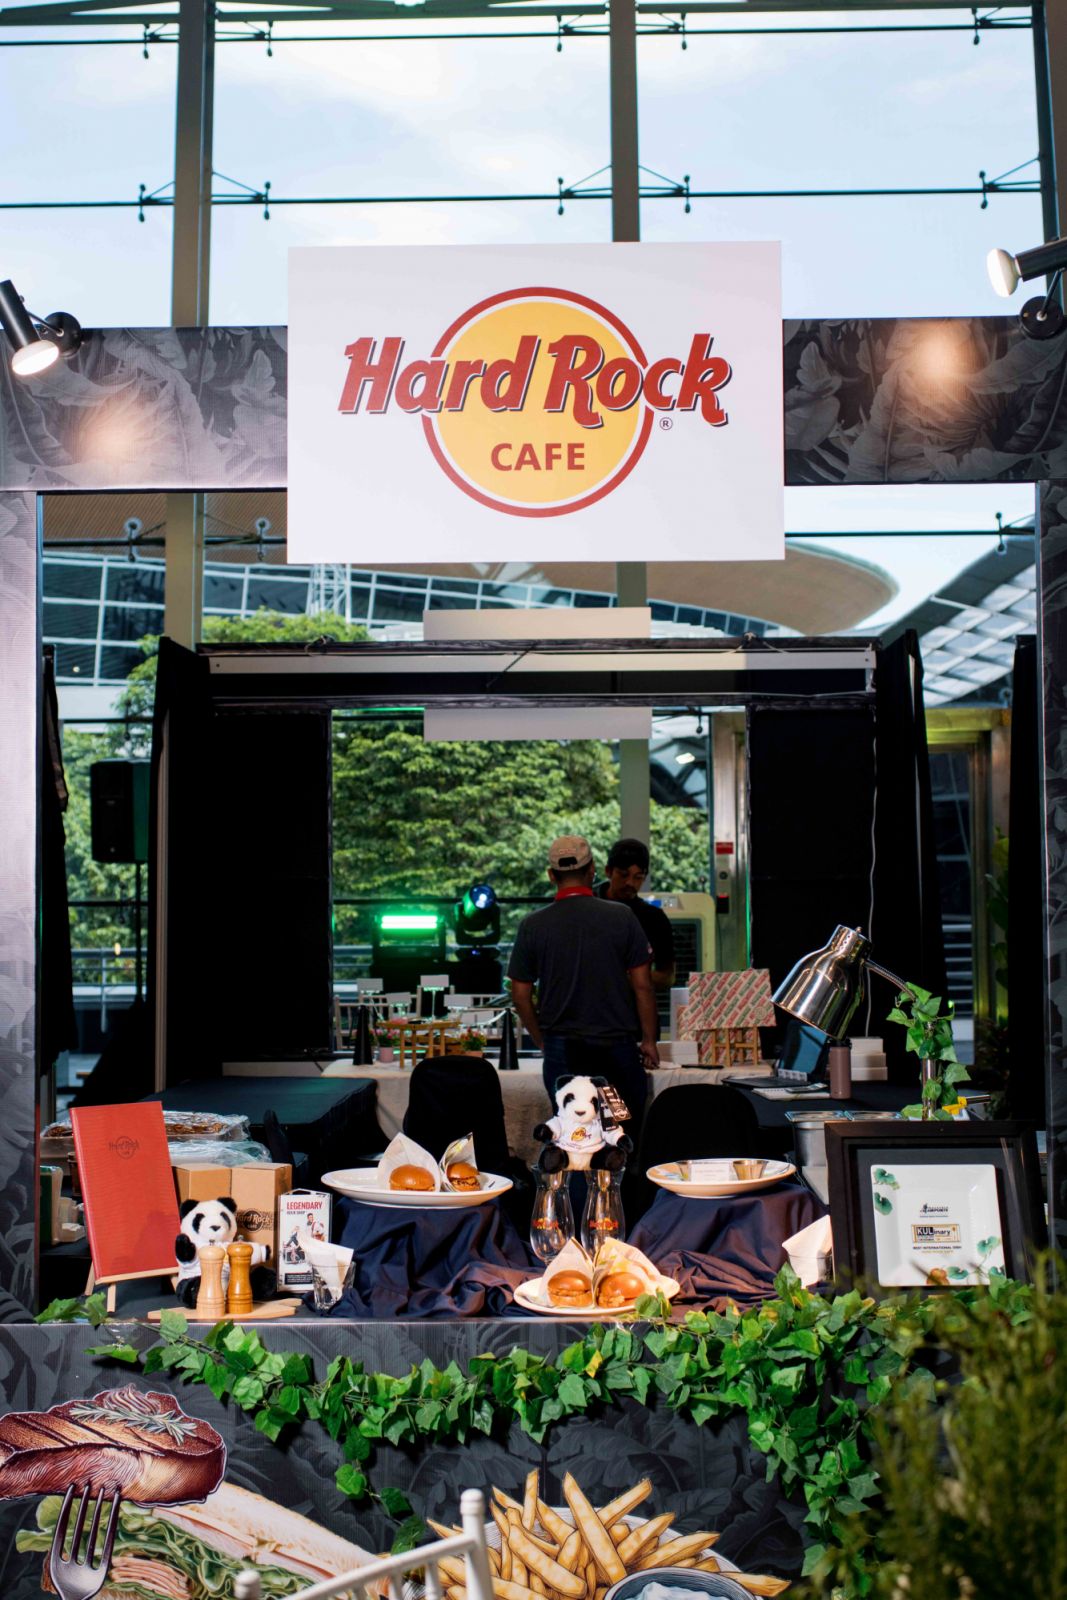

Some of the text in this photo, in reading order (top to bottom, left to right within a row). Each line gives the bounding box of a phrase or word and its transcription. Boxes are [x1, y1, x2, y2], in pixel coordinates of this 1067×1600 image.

[338, 333, 732, 429] Hard Rock
[490, 441, 586, 472] CAFE
[286, 1201, 323, 1210] LEGENDARY
